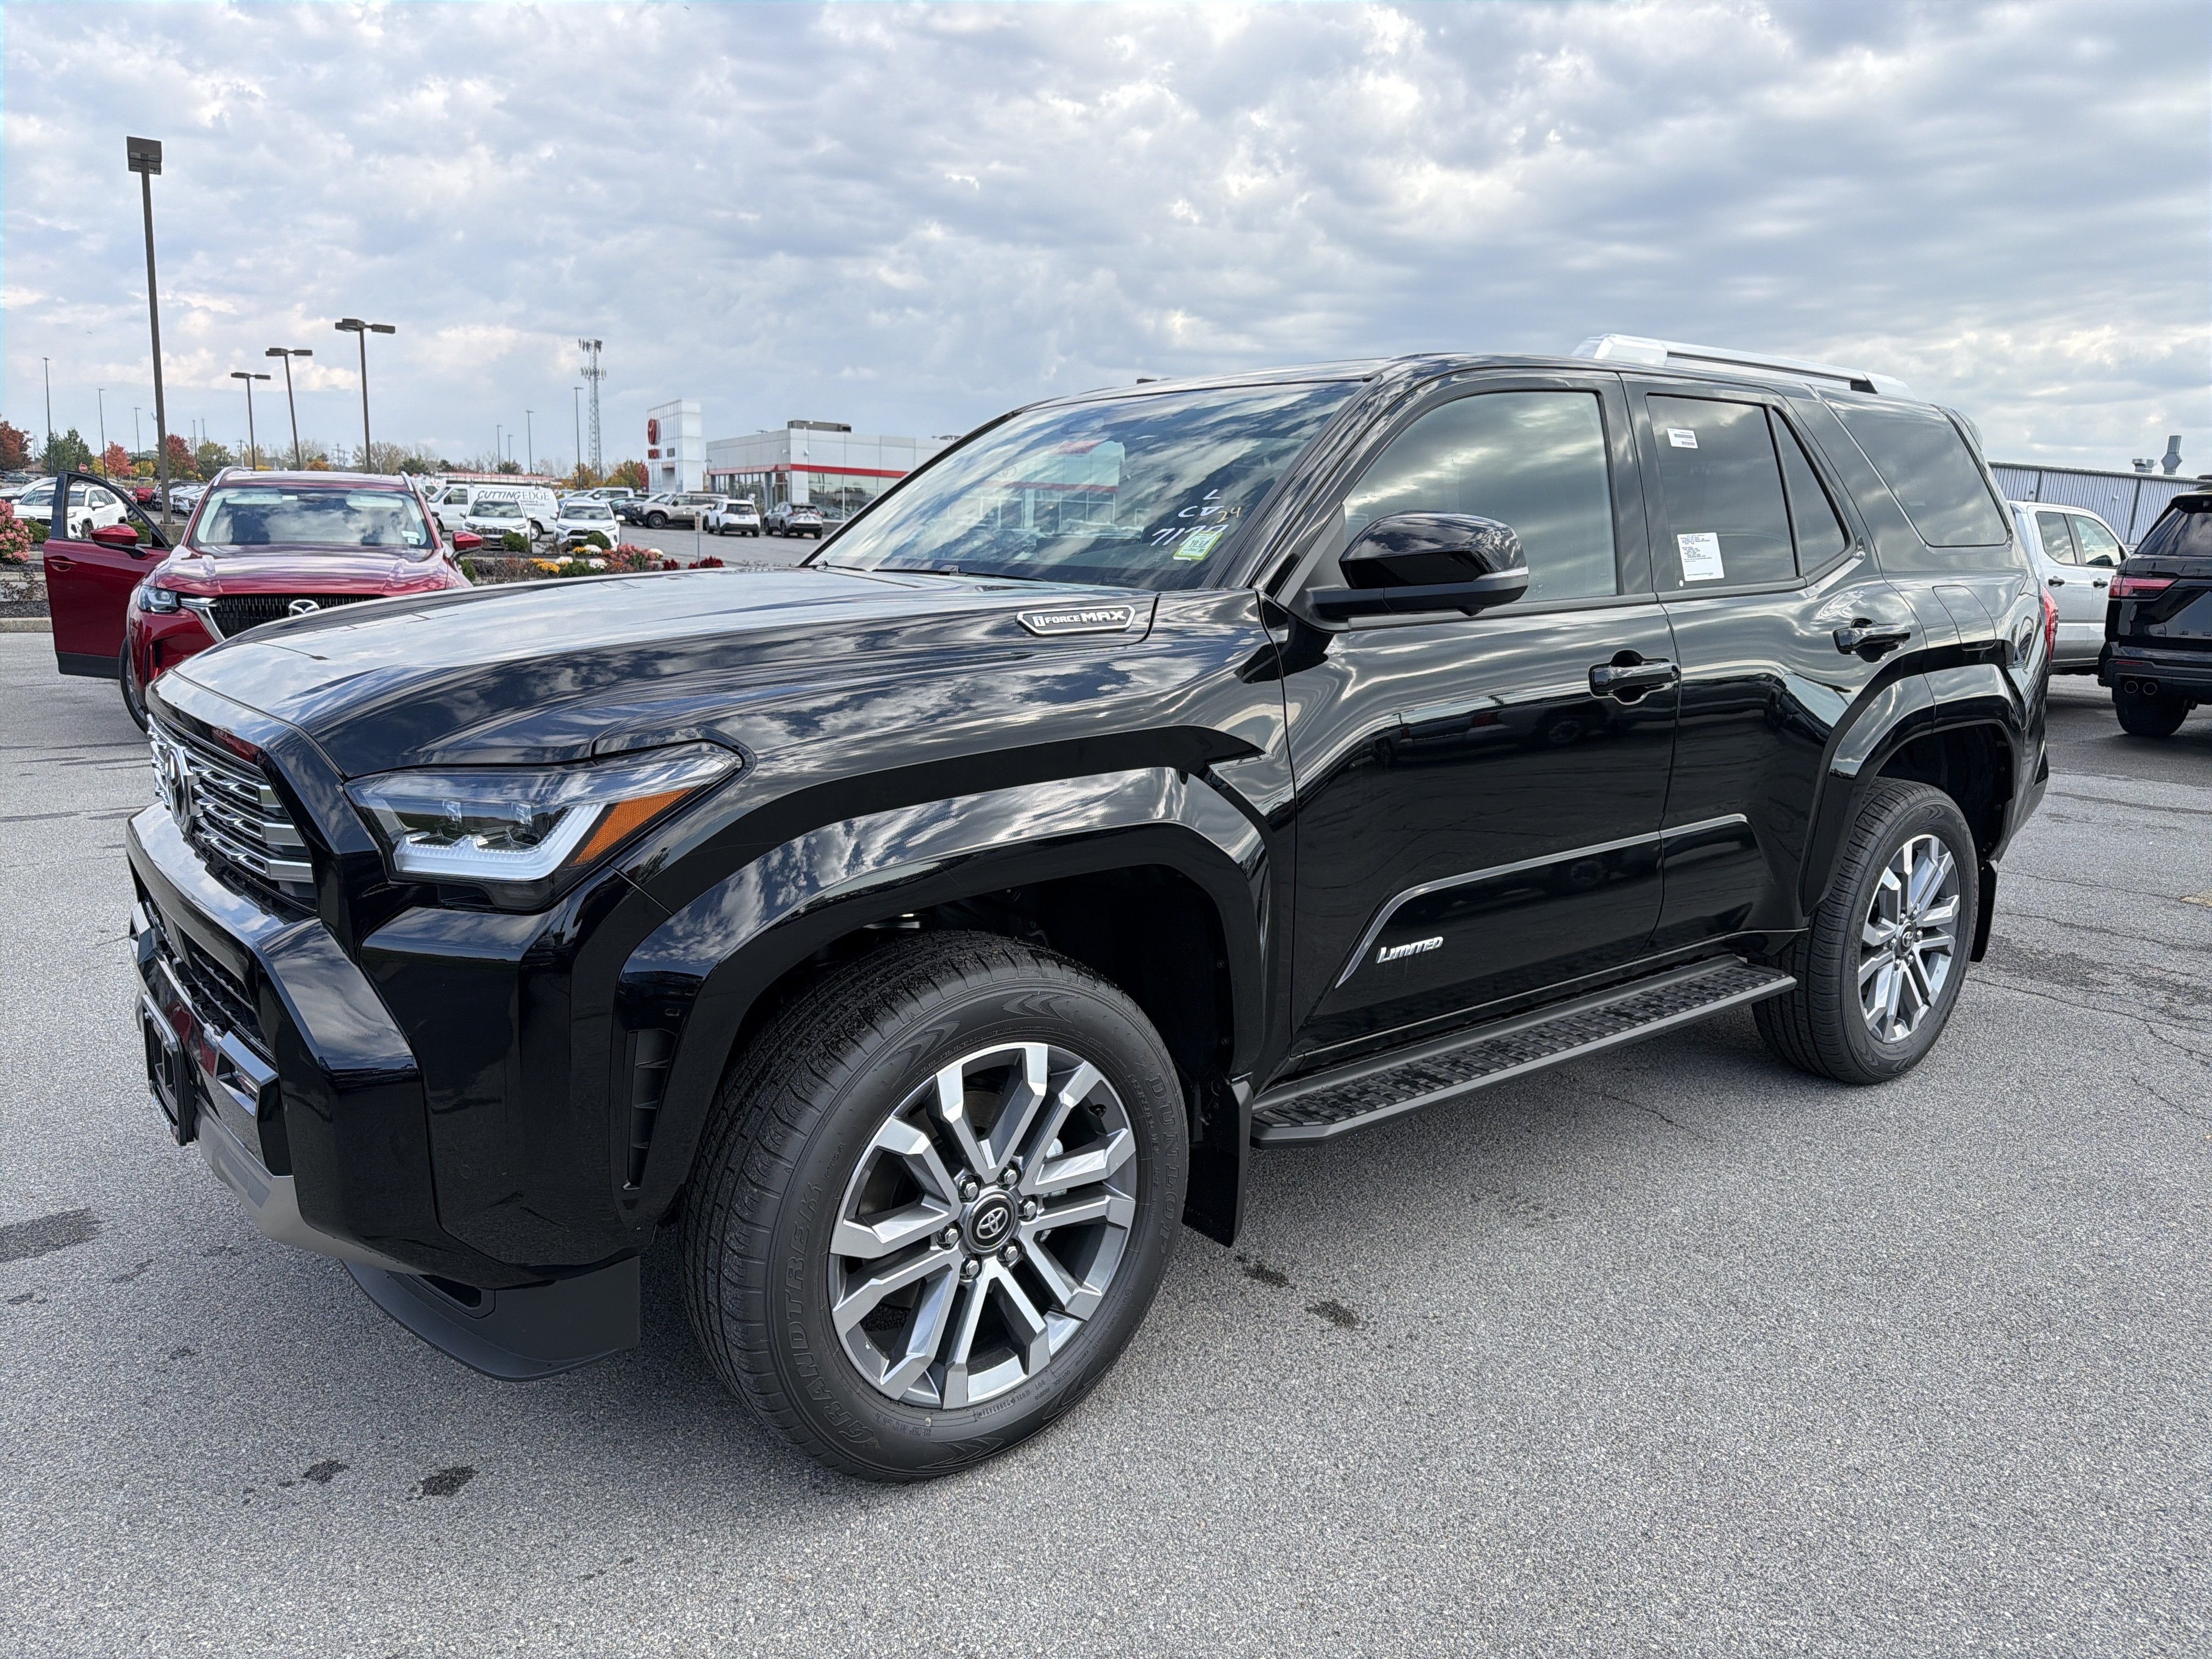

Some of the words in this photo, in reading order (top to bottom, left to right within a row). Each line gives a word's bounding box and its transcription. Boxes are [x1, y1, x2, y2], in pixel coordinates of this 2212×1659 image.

[477, 490, 522, 500] CUTTING
[521, 491, 550, 500] EDGE
[1216, 506, 1242, 523] 24
[1080, 611, 1127, 623] MAX
[1375, 936, 1444, 964] LIMITED
[1146, 1074, 1180, 1254] DUNLOP
[785, 1181, 875, 1444] GRANDTREK
